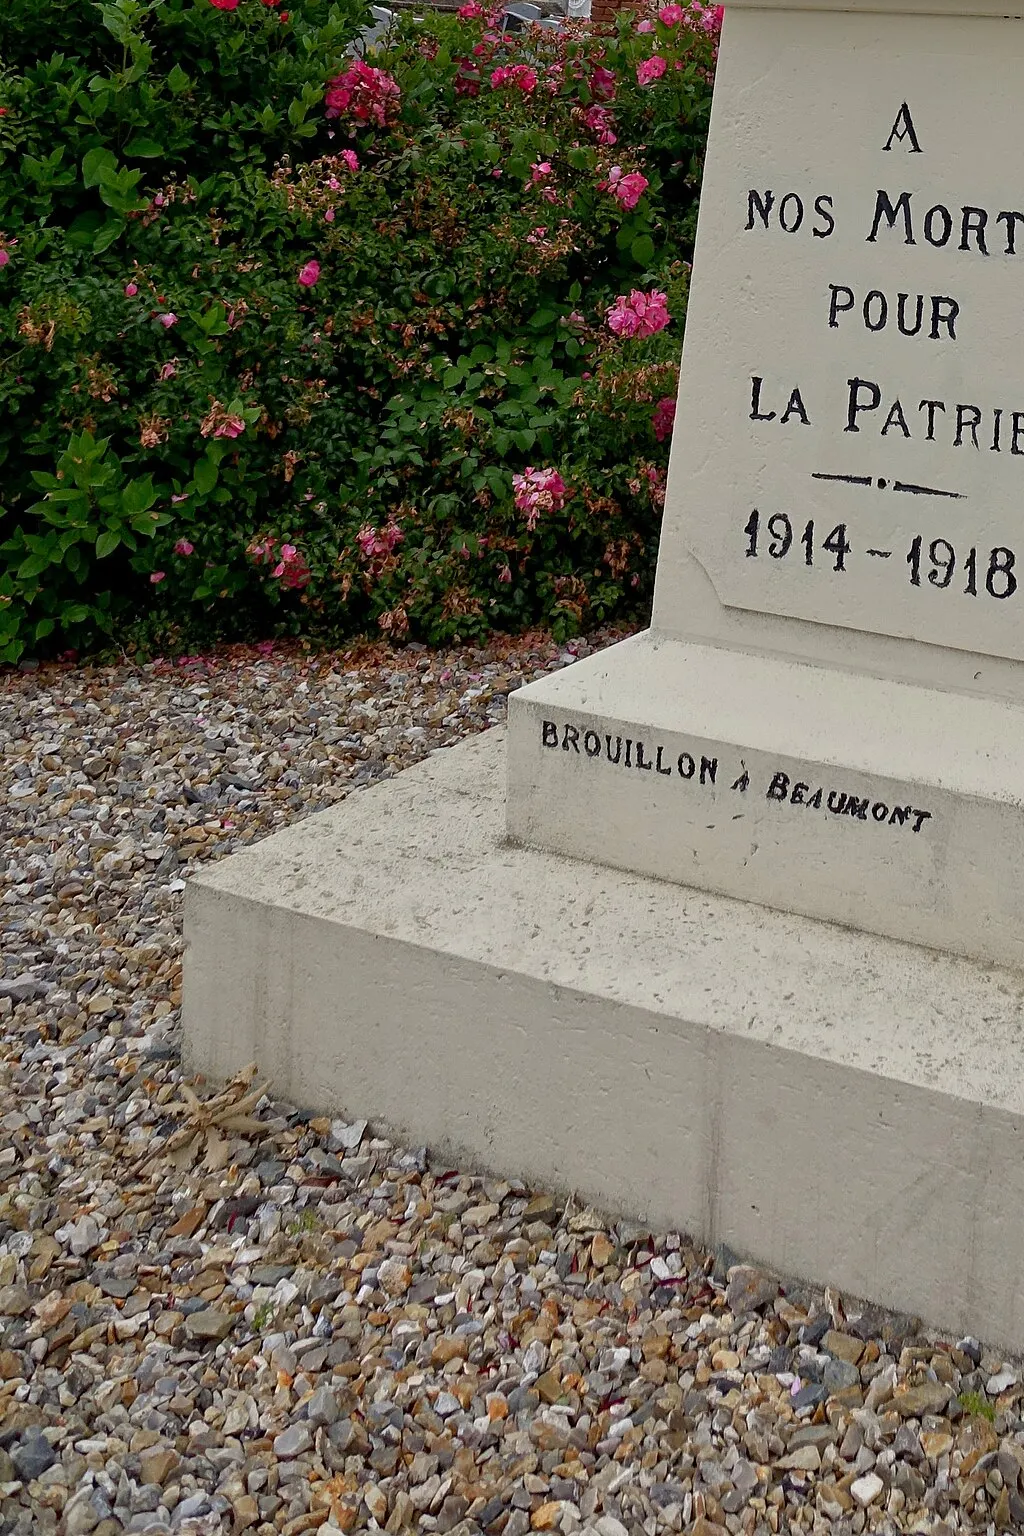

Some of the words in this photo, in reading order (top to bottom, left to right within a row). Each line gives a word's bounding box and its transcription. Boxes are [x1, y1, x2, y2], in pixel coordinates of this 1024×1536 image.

[882, 100, 924, 154] A
[743, 189, 835, 240] NOS
[827, 283, 961, 341] POUR
[748, 376, 812, 426] LA
[540, 719, 720, 786] BROUILLON
[765, 771, 933, 834] BEAUMONT
